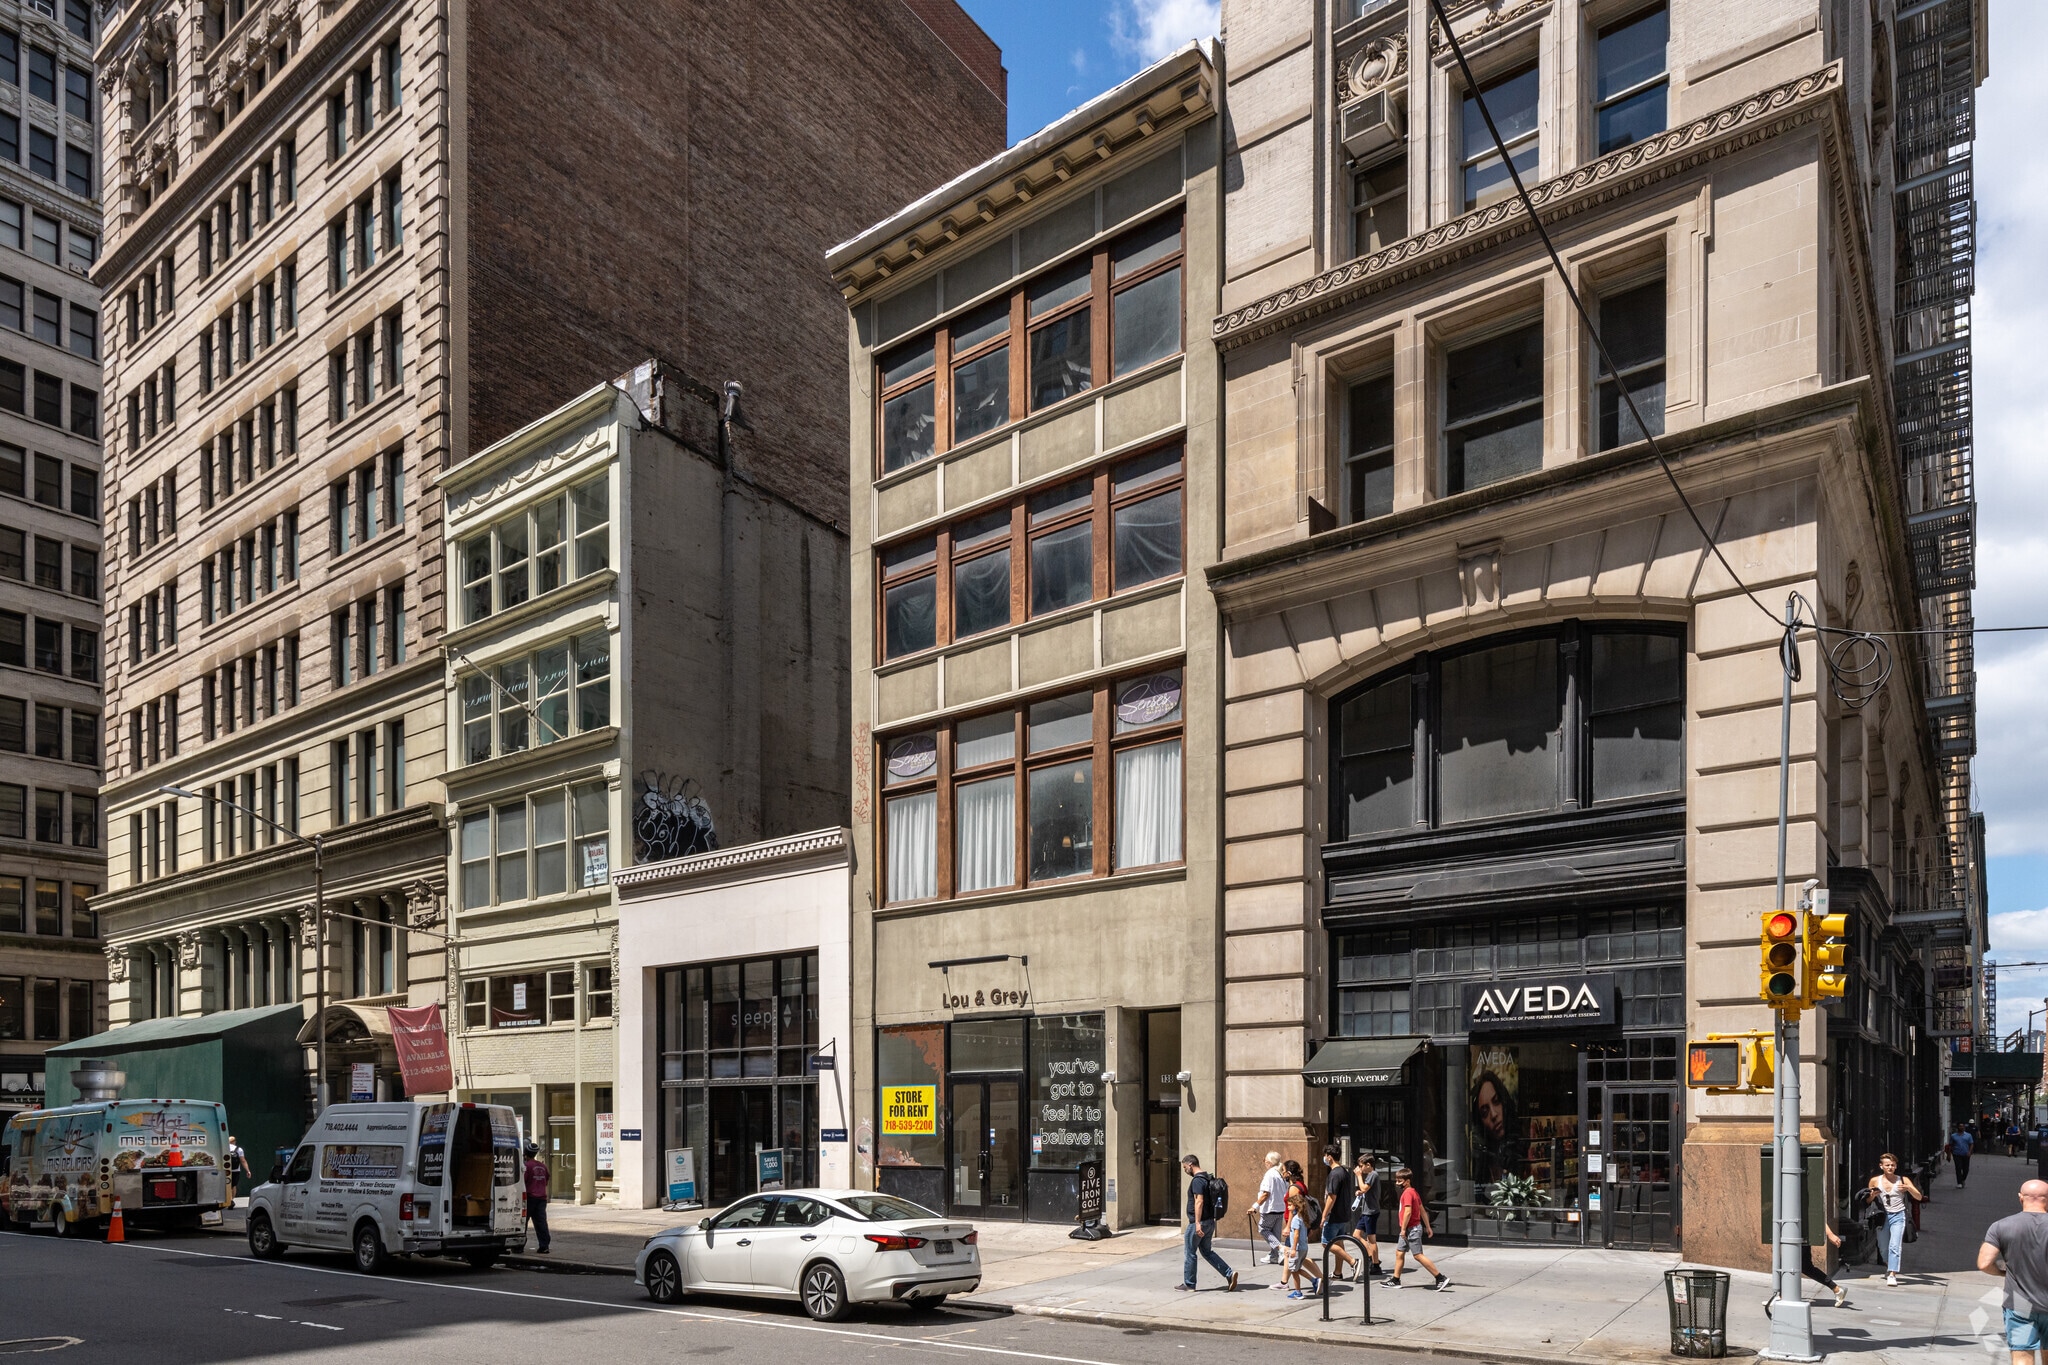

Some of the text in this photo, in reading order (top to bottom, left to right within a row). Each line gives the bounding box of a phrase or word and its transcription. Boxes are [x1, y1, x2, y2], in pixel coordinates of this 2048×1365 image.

[942, 988, 1028, 1008] Lou & Grey
[1473, 982, 1600, 1015] AVEDA
[731, 1010, 772, 1030] seep
[394, 1024, 416, 1034] PRIME
[411, 1038, 434, 1046] SPACE
[406, 1050, 445, 1062] AVAILABLE
[1476, 1052, 1514, 1064] AVEDA
[1048, 1058, 1096, 1078] you've
[1331, 1074, 1351, 1084] Fifth
[1050, 1081, 1094, 1100] got to
[895, 1090, 922, 1104] STORE
[889, 1105, 928, 1118] FOR RENT
[1042, 1104, 1101, 1121] feel it to
[324, 1123, 358, 1131] 718.402.4444
[885, 1120, 933, 1130] 718-539-2200
[120, 1136, 145, 1146] MIS
[1040, 1128, 1104, 1145] believe it
[324, 1150, 370, 1170] Aggressive
[1082, 1178, 1100, 1190] FIVE
[1082, 1189, 1100, 1200] IRON
[1082, 1198, 1100, 1208] GOLF
